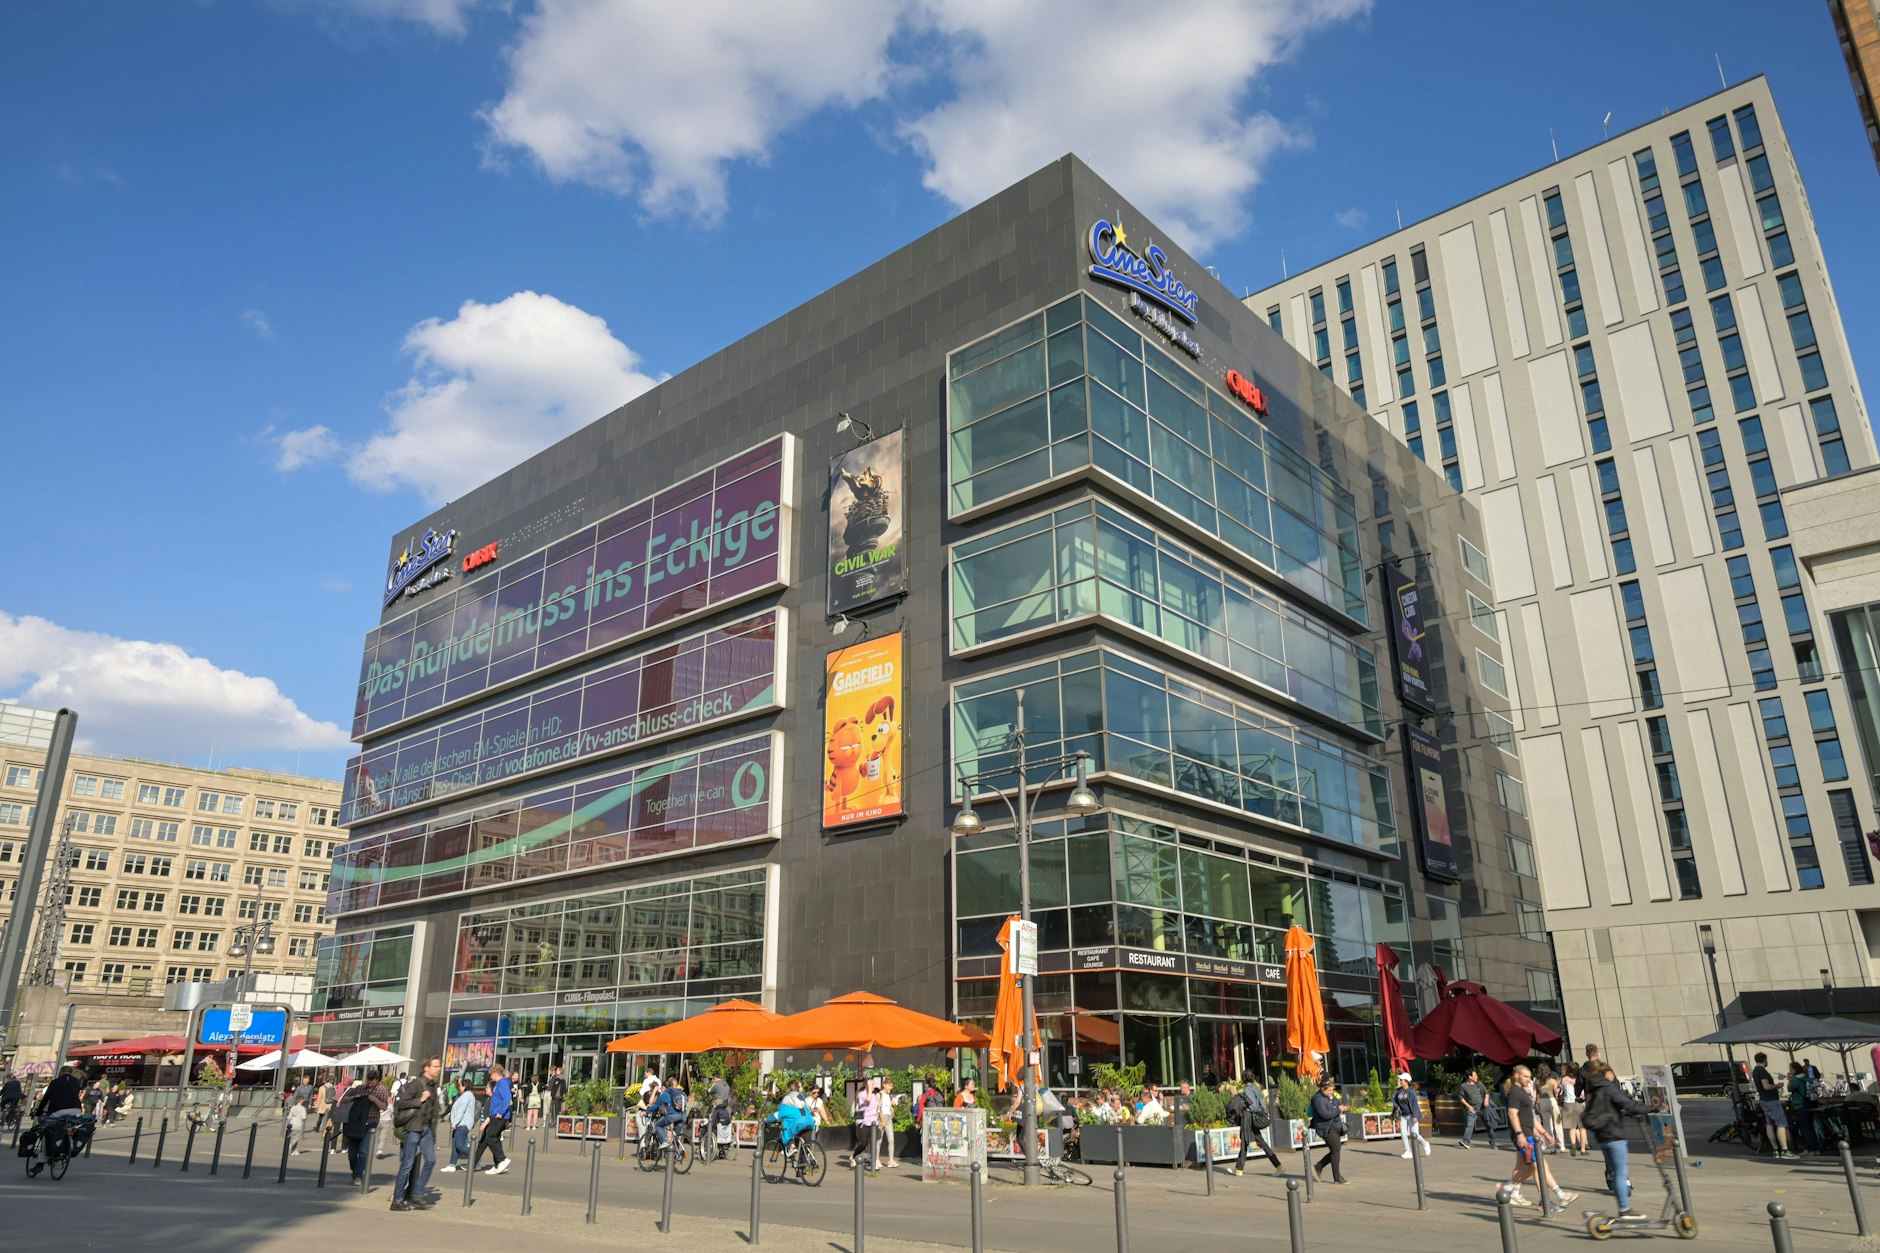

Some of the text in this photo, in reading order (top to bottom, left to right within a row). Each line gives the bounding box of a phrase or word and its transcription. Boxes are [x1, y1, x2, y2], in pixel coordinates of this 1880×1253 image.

[1090, 220, 1198, 311] CineStar
[1227, 369, 1270, 416] CUBIX
[386, 529, 455, 595] CineStar
[834, 554, 866, 575] CIVIL
[868, 543, 897, 563] WAR
[364, 500, 777, 700] Das Runde muss ins Eckige
[833, 662, 894, 691] GARFIELD
[346, 800, 369, 821] Mach
[486, 758, 504, 781] auf
[505, 691, 733, 775] vodafone.de/tv-anschluss-check
[402, 763, 419, 782] alle
[420, 749, 471, 776] deutschen
[473, 729, 526, 760] EM-Spiele
[528, 725, 539, 743] in
[541, 716, 563, 738] HD:
[646, 786, 725, 815] Together we can
[866, 808, 882, 817] KINO
[1077, 948, 1109, 957] RESTAURANT
[1083, 961, 1104, 969] LOUNGE
[1086, 954, 1100, 962] CAFÉ
[1128, 952, 1176, 968] RESTAURANT
[1265, 967, 1281, 979] CAFÉ
[338, 1010, 362, 1019] restaurant
[366, 1008, 375, 1017] bar
[378, 1007, 395, 1018] lounge
[208, 1032, 276, 1042] Alexaderplatz
